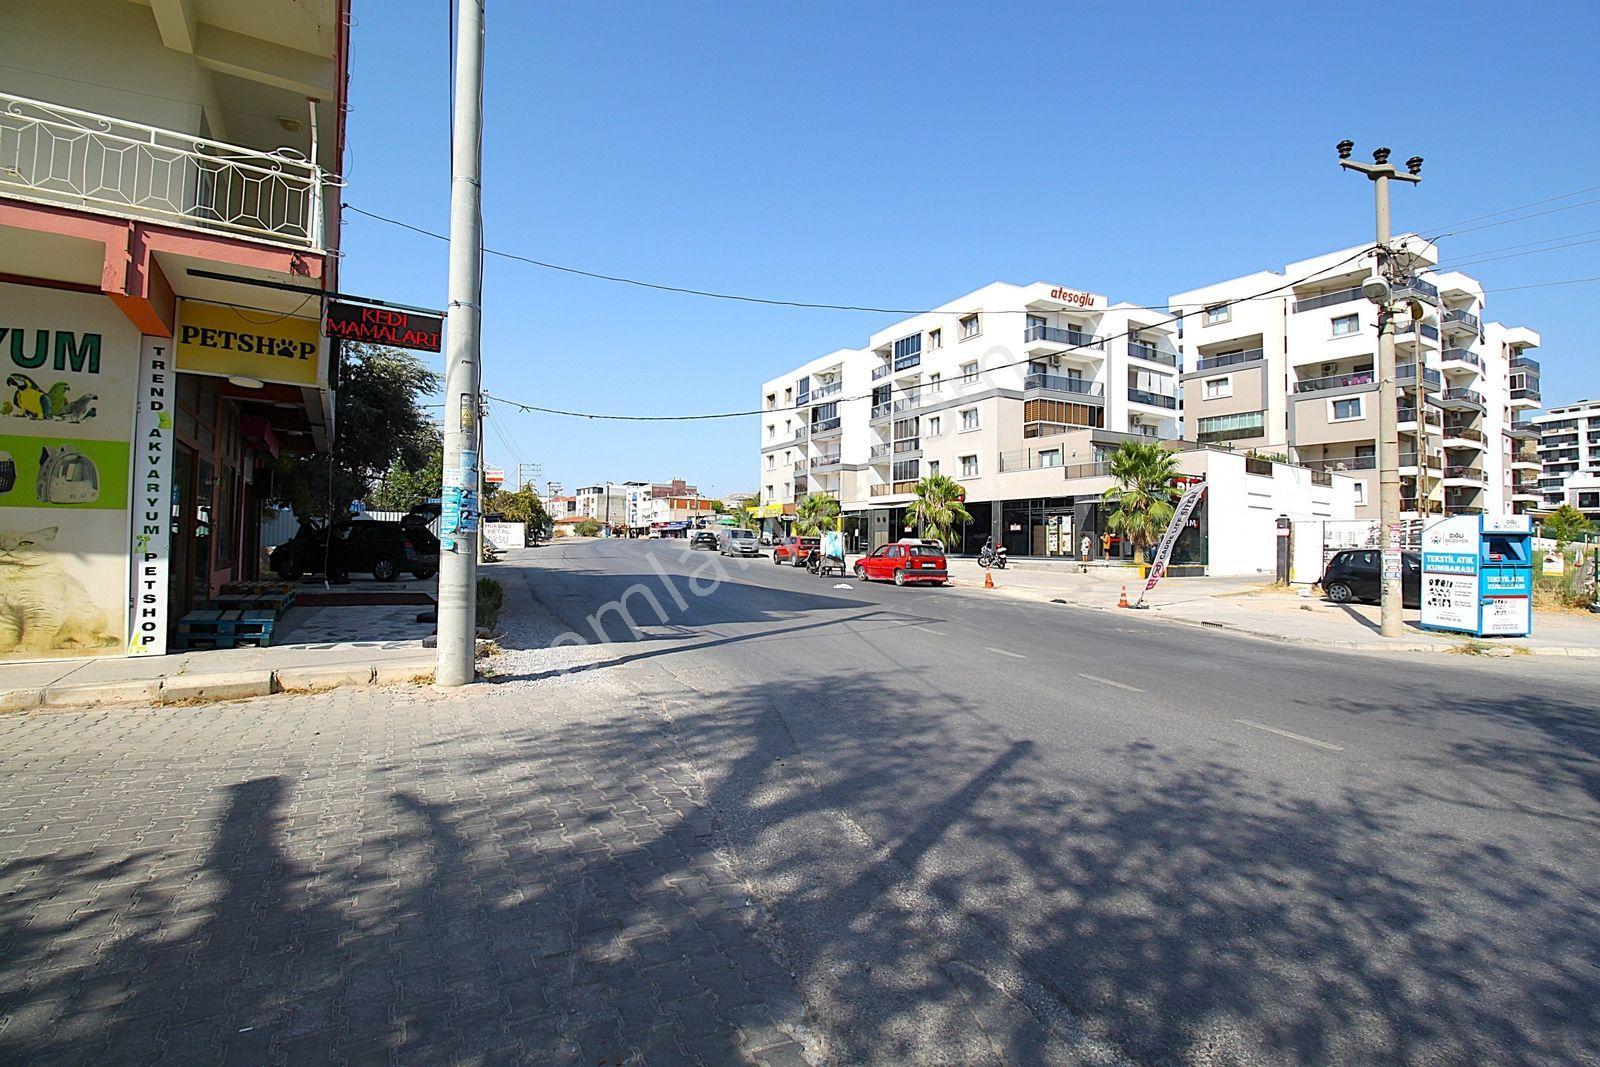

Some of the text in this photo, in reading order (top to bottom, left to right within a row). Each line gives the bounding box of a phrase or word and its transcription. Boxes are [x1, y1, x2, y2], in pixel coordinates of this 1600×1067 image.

[1051, 286, 1094, 307] ateşoğlu
[327, 318, 439, 347] MAMALARI
[0, 328, 102, 374] UM
[141, 346, 165, 645] TREND AKVARYUM PETSHOP
[1426, 554, 1474, 565] TEKSTİL ATIK
[1426, 564, 1474, 573] KUMBARASI
